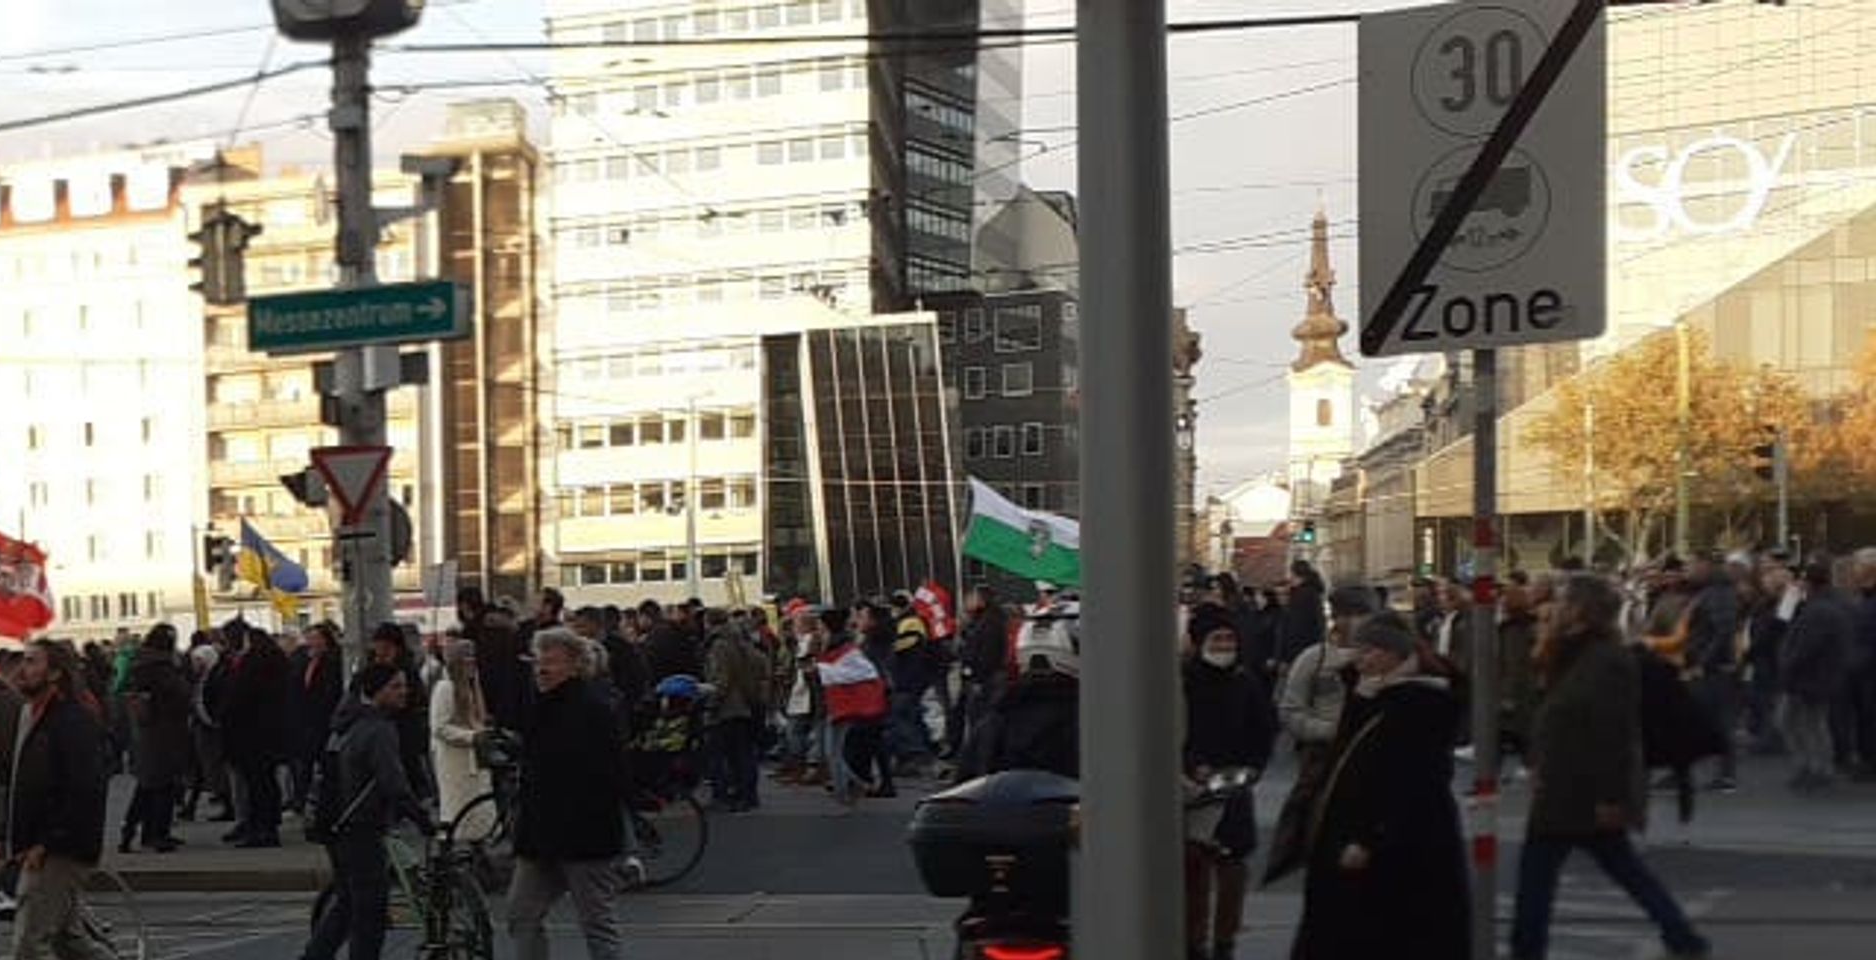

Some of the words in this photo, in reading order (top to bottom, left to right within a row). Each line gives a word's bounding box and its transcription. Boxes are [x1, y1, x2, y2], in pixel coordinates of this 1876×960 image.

[1440, 29, 1523, 112] 30
[257, 302, 412, 335] Messezentrum
[1402, 284, 1562, 342] Zone
